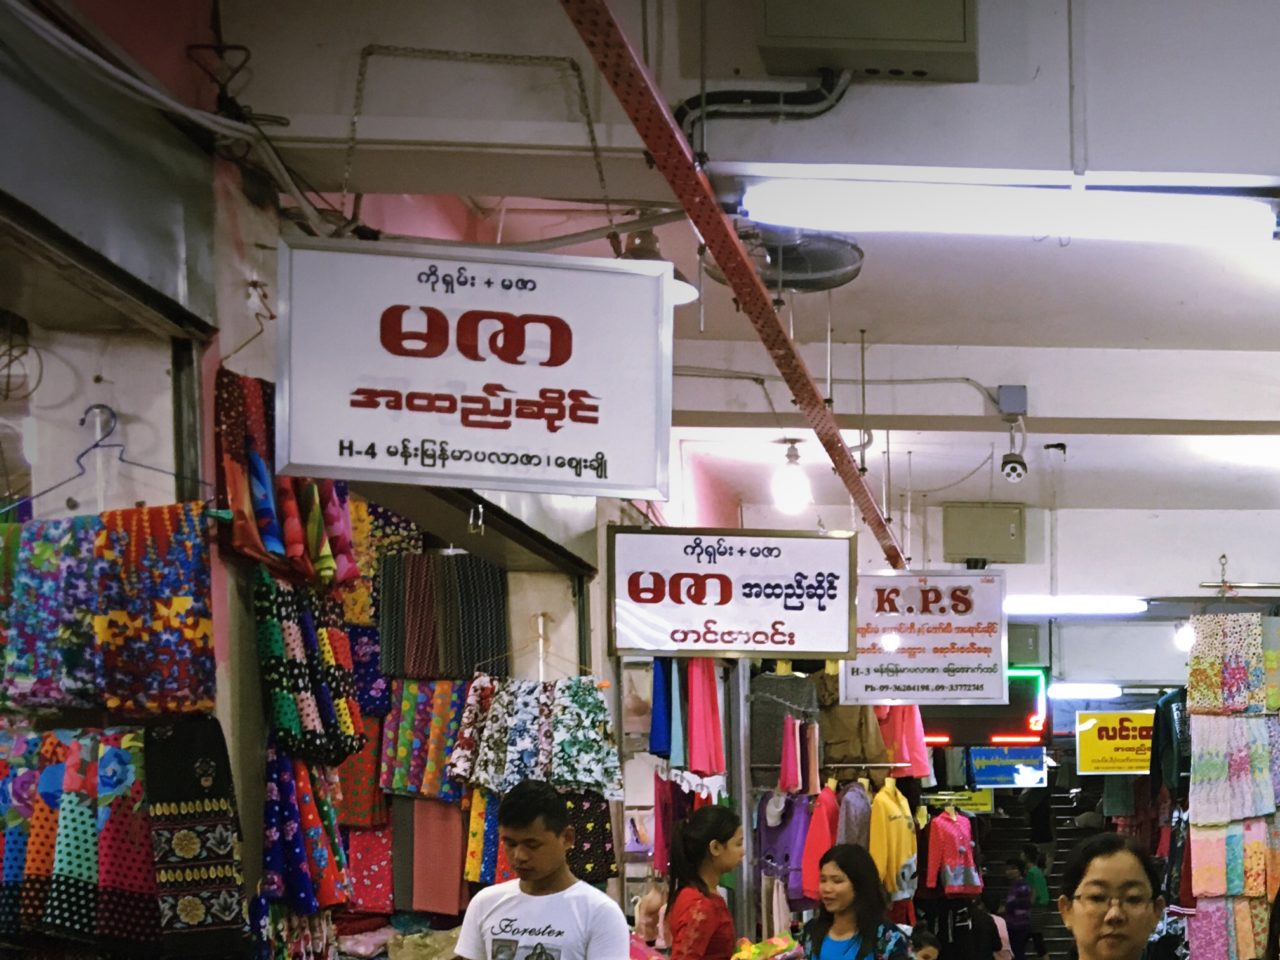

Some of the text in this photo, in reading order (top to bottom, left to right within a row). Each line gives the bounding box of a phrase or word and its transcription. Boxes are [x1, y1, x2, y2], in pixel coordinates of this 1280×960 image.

[417, 265, 476, 294] ကိုရှမ်း
[501, 279, 536, 291] မဇာ
[380, 305, 572, 367] မဇာ
[350, 383, 601, 433] အထည်ဆိုင်
[339, 440, 377, 459] H-4
[750, 547, 781, 558] မဇာ
[628, 571, 840, 611] မဇာ အထည်ဆိုင်
[491, 918, 564, 937] Forester
